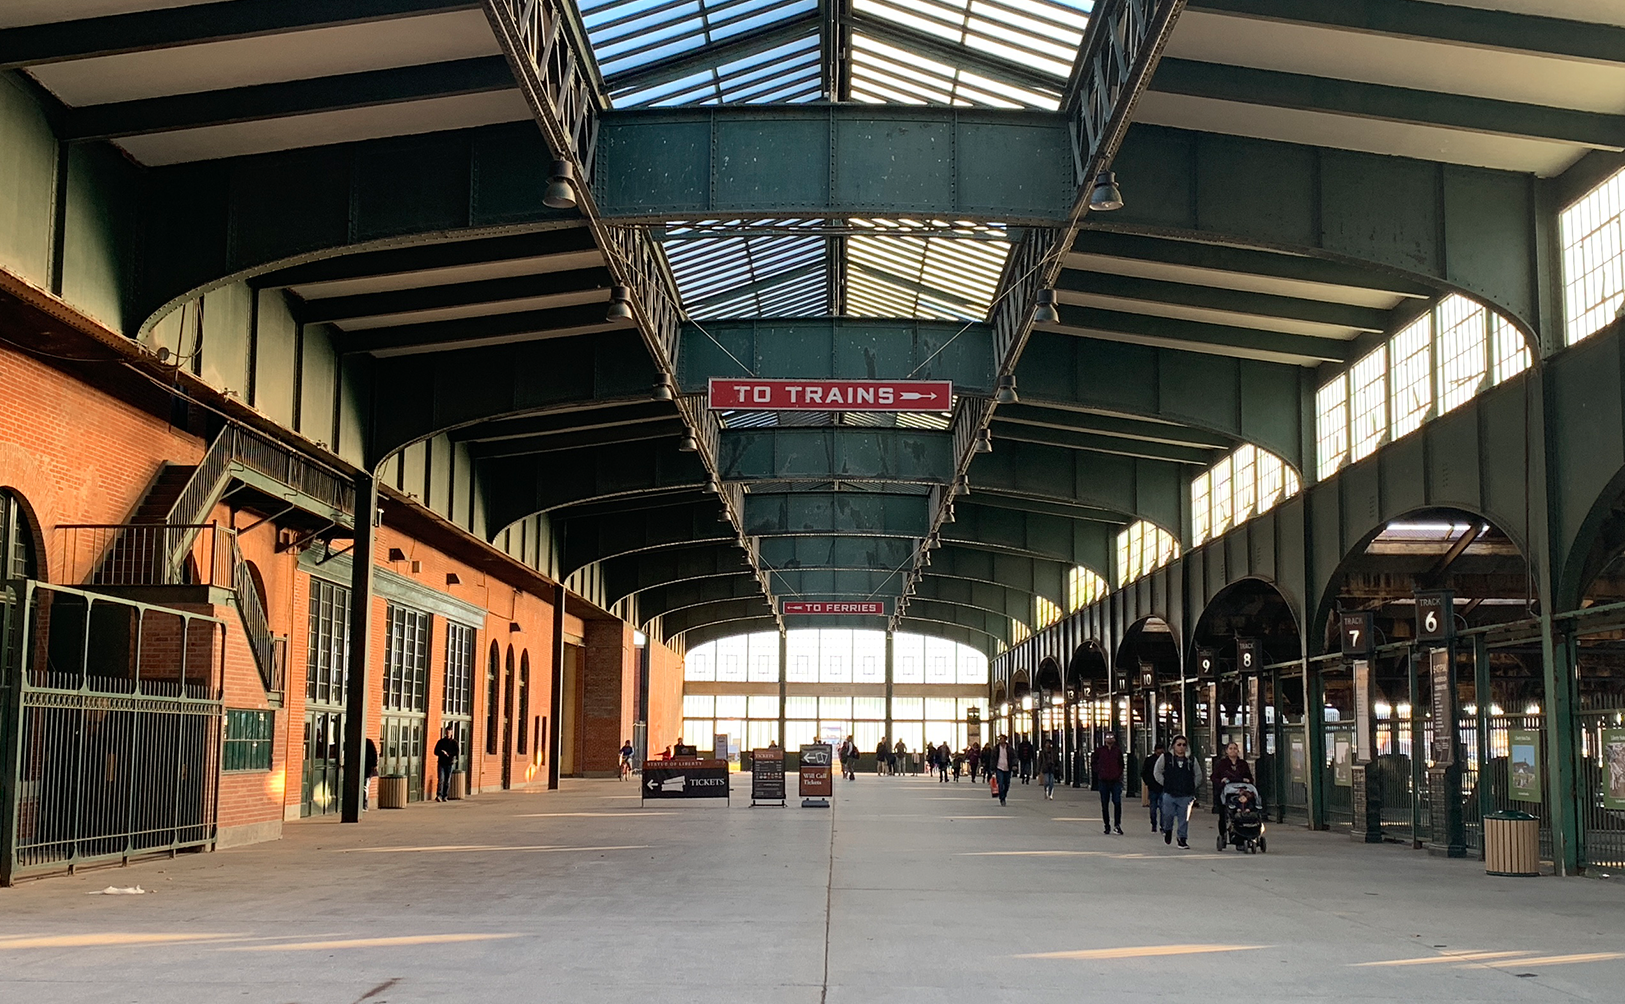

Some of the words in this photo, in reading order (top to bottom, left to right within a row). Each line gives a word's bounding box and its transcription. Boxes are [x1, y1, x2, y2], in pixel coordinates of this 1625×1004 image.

[734, 386, 771, 403] TO
[785, 386, 894, 404] TRAINS
[1420, 598, 1441, 607] TRACK
[805, 604, 821, 612] TO
[826, 604, 877, 612] FERRIES
[1344, 618, 1363, 626] TRACK
[1425, 611, 1438, 633] 6
[1349, 630, 1360, 647] 7
[1243, 652, 1252, 667] 8
[1202, 659, 1211, 673] 9
[1119, 679, 1125, 689] 11
[1143, 673, 1152, 685] 10
[1067, 690, 1074, 699] 13
[1083, 687, 1091, 697] 12
[690, 778, 725, 786] TICKETS
